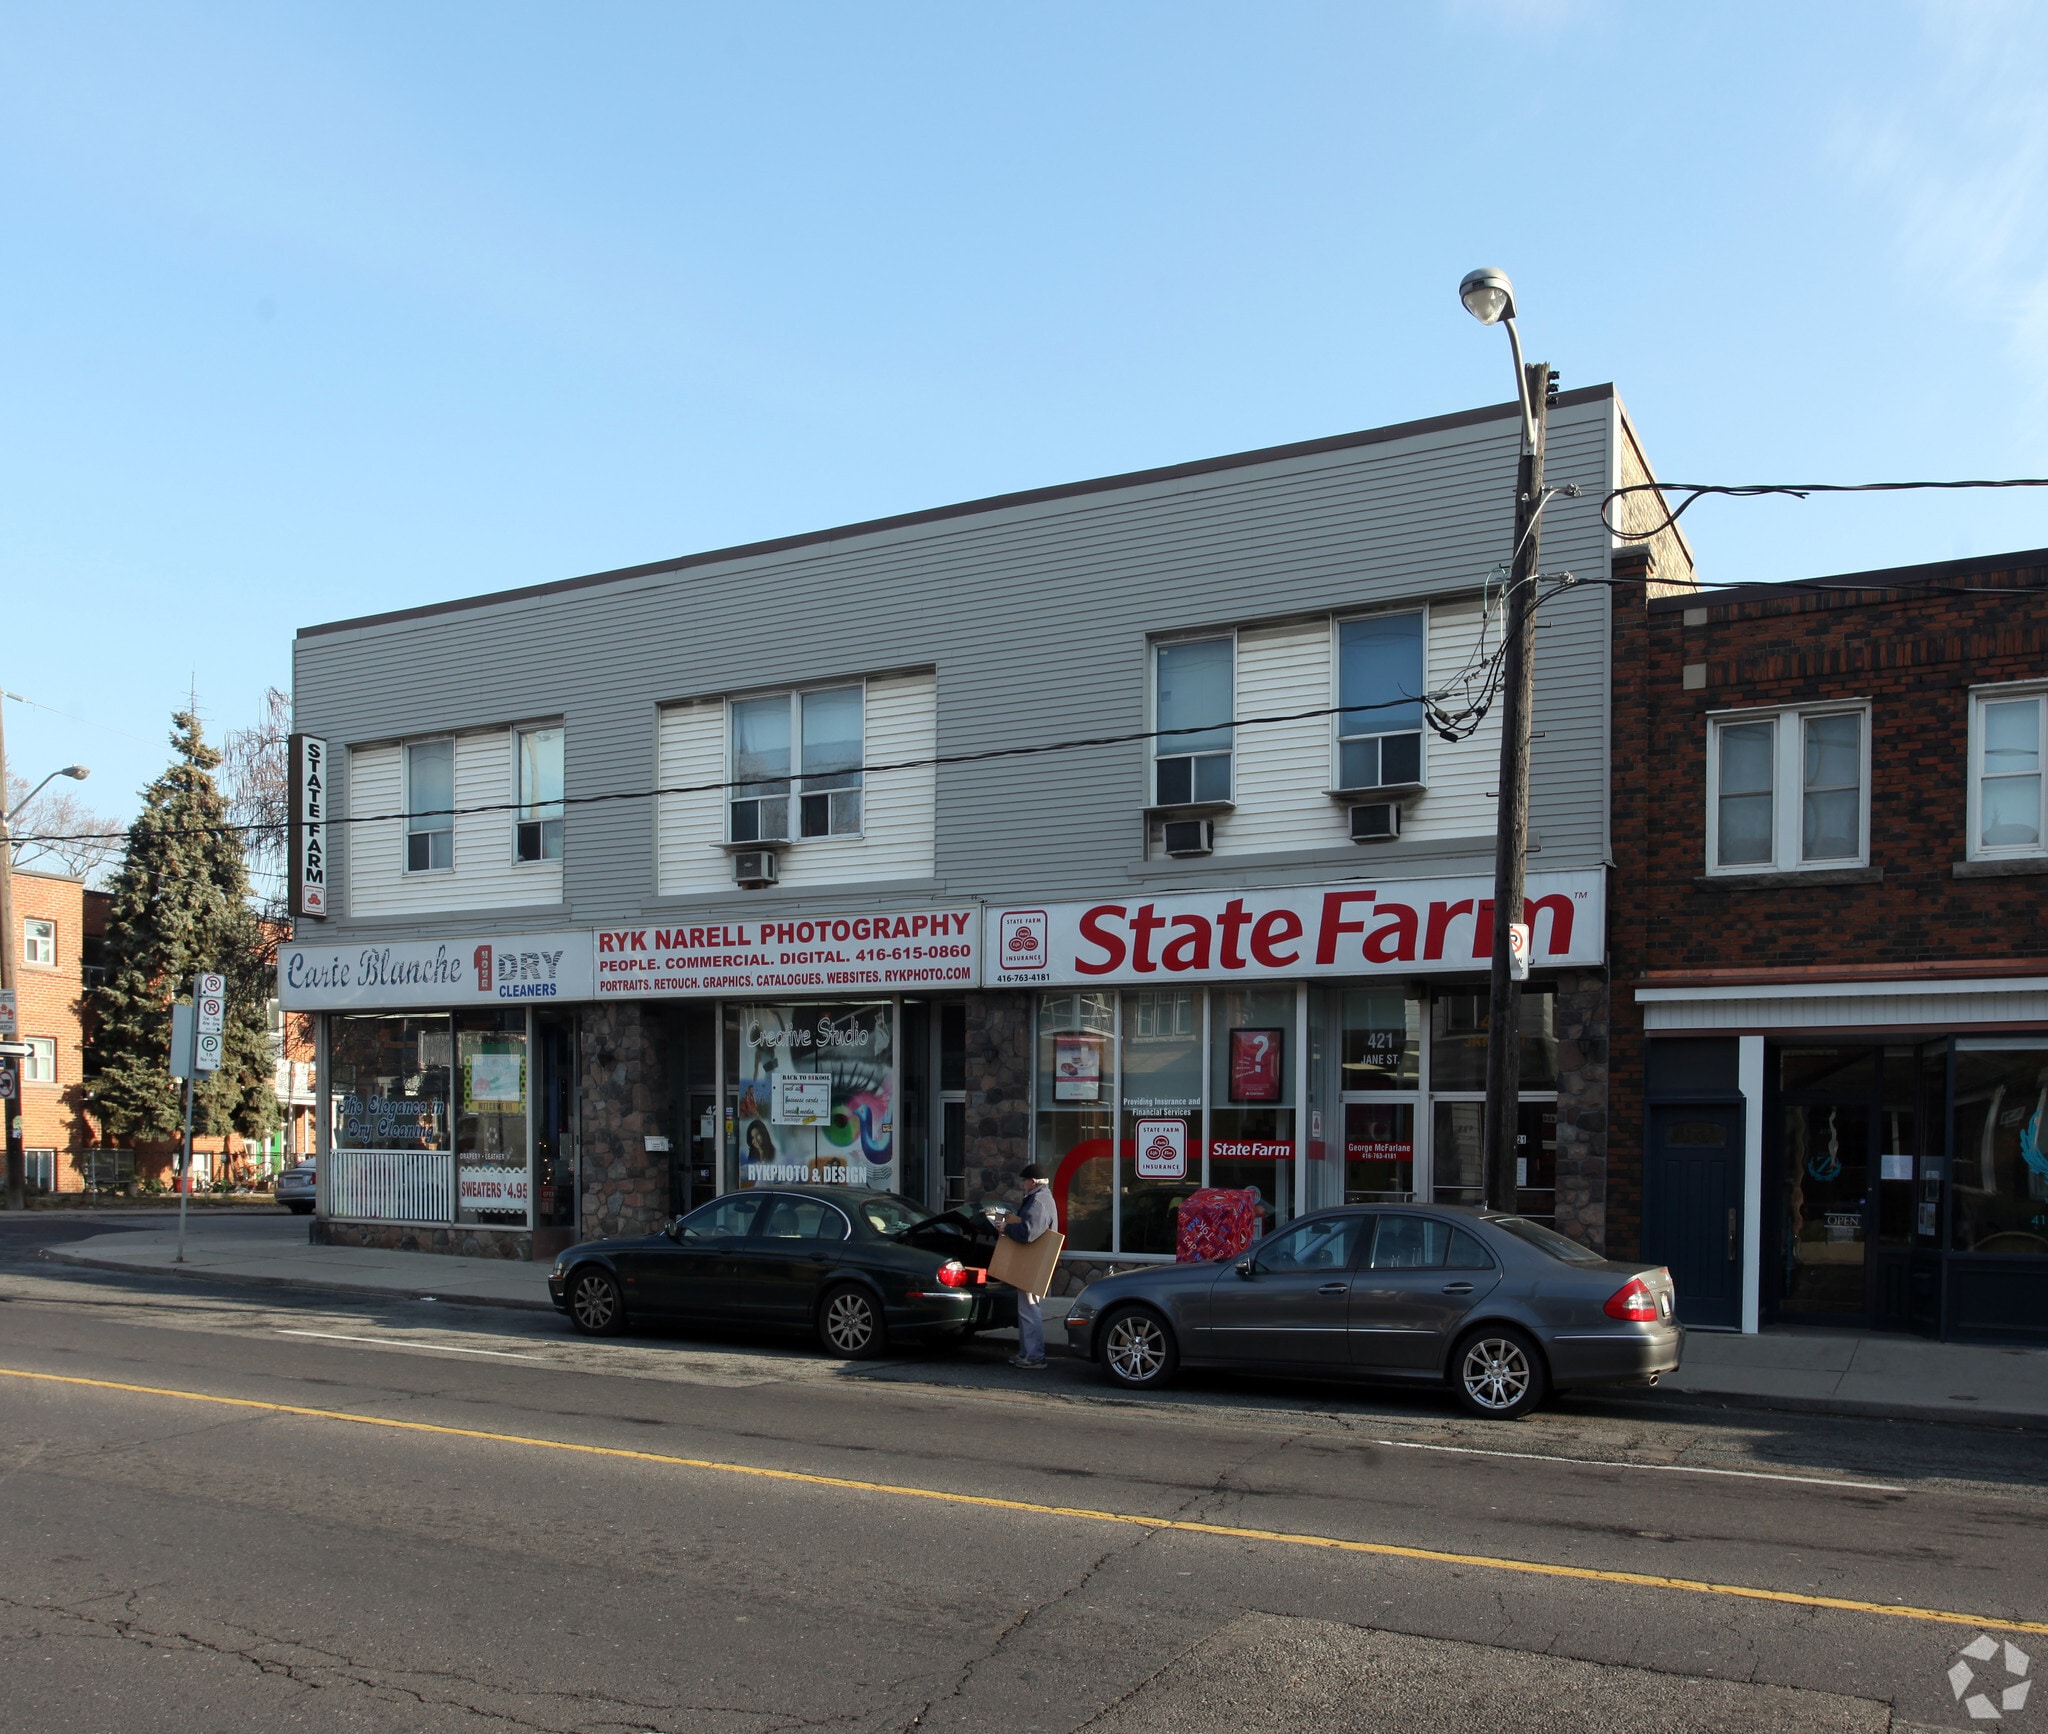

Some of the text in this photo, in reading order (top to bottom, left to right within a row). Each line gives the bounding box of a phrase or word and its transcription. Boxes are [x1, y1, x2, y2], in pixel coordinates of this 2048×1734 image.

[306, 743, 322, 818] STATE
[306, 823, 324, 884] FARM
[599, 912, 971, 953] RYK NARELL PHOTOGRAPHY
[1075, 898, 1303, 975] State
[1315, 890, 1575, 965] Farm
[357, 944, 463, 988] Blanche
[498, 950, 564, 981] DRY
[600, 944, 971, 972] PEOPLE. COMMERCIAL. DIGITAL. 416-615-0860
[1006, 954, 1041, 962] INSURANCE
[600, 967, 971, 992] PORTRAITS. RETOUCH. GRAPHICS. CATALOGUES. WEBSITES. RYKPHOTO.COM
[997, 973, 1050, 982] 416-763-4181
[499, 983, 557, 998] CLEANERS
[745, 1016, 869, 1048] Creative Studio
[1367, 1032, 1393, 1049] 421
[1360, 1054, 1400, 1065] JANE ST.
[338, 1094, 445, 1119] The Elegance in
[1123, 1097, 1201, 1107] Providing Insurance and
[1132, 1108, 1191, 1116] Financial Services
[348, 1117, 434, 1144] Dry Cleaning
[1212, 1142, 1291, 1156] State Farm
[1348, 1143, 1411, 1153] George McFarlane
[747, 1164, 868, 1184] RYKPHOTO & DESIGN
[461, 1181, 502, 1198] SWEATERS
[1827, 1215, 1859, 1226] OPEN
